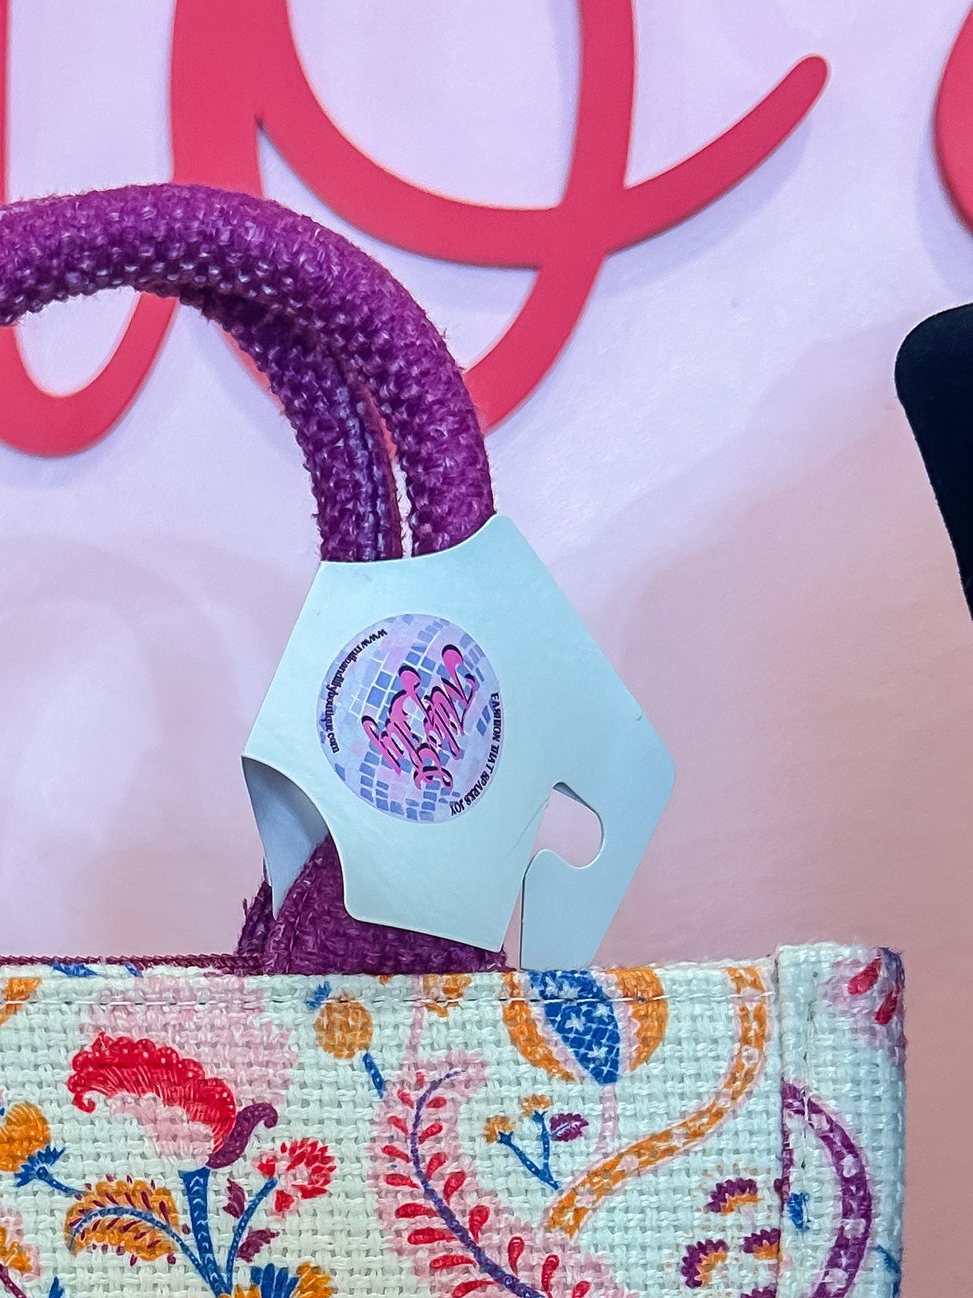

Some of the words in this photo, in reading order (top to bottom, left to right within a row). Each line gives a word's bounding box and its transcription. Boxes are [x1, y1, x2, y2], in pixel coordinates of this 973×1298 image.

[490, 692, 501, 743] FASHION
[466, 772, 491, 806] SPARKS
[450, 801, 466, 816] JOY
